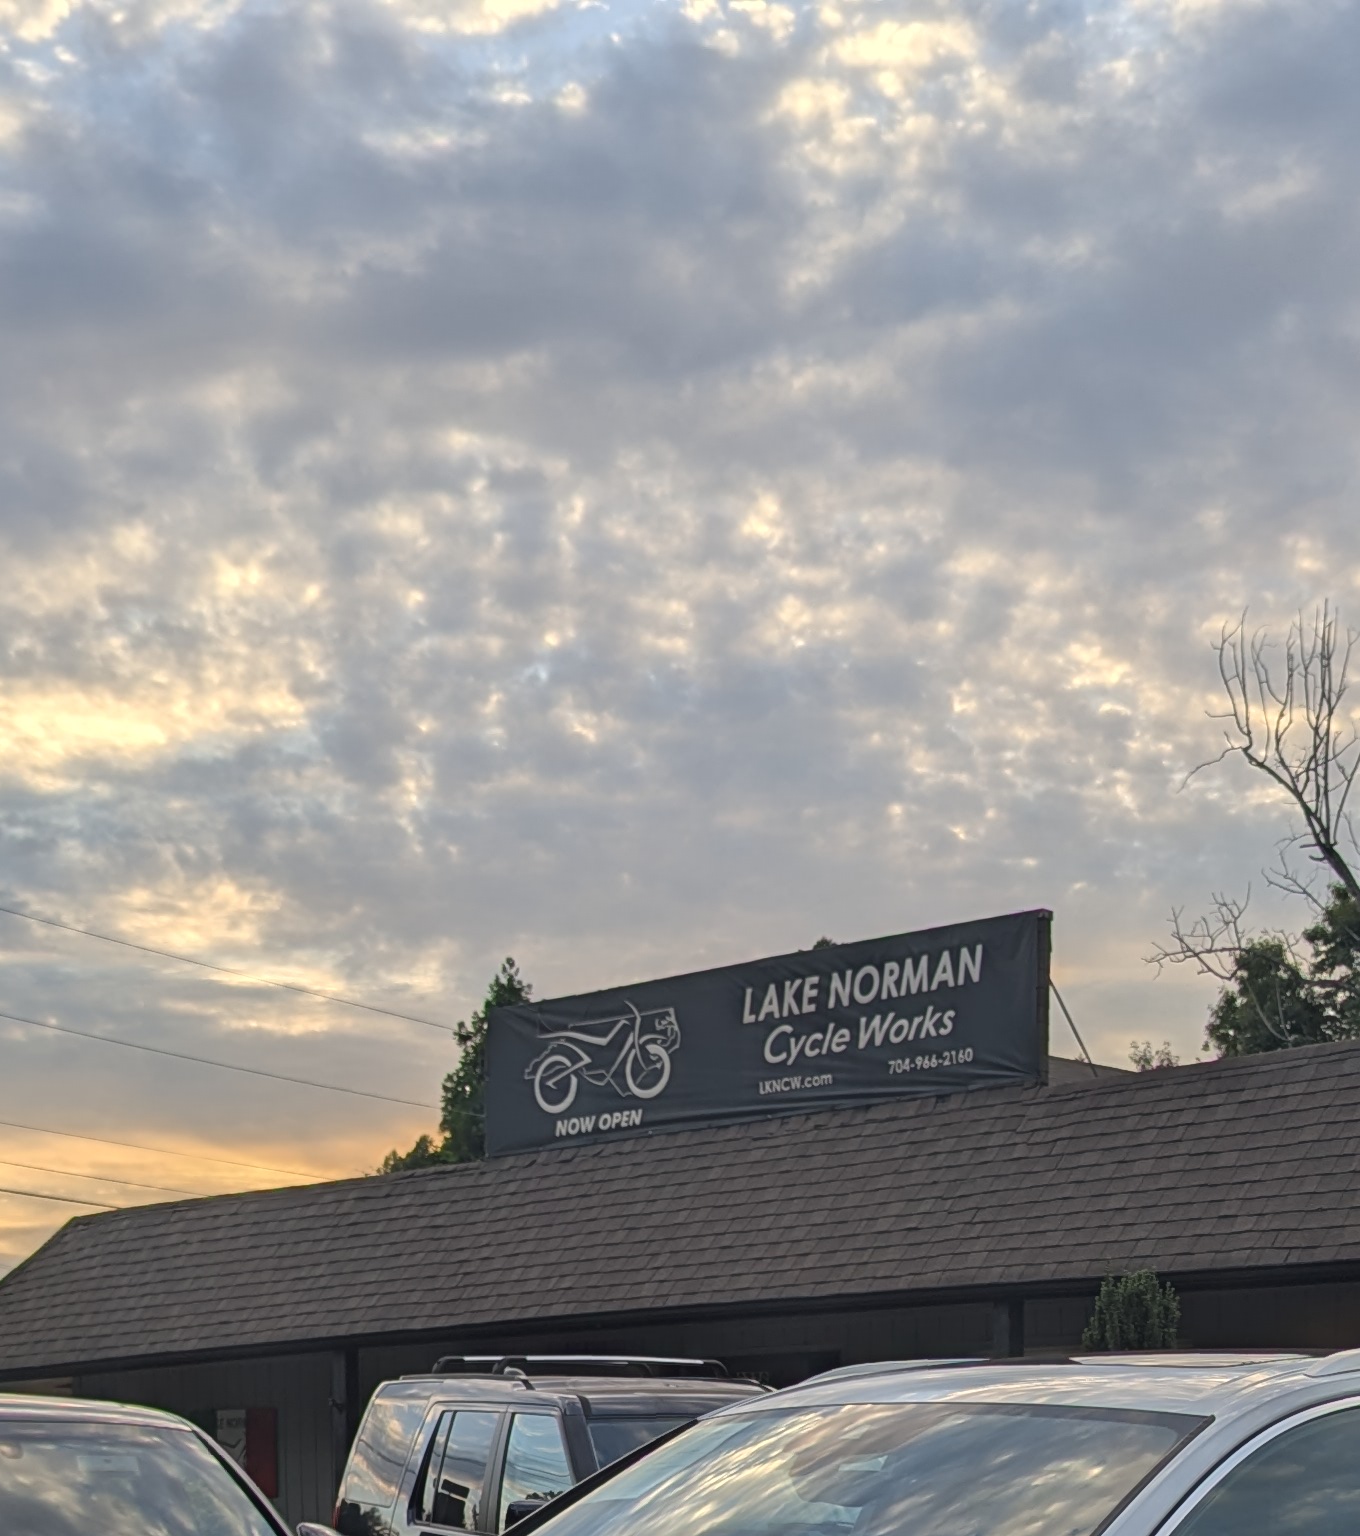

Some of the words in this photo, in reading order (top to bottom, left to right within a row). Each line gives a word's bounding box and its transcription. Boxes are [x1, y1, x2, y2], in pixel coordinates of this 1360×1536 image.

[742, 974, 820, 1025] LAKE
[827, 943, 984, 1010] NORMAN
[762, 1022, 852, 1066] Cycle
[857, 1004, 956, 1051] Works
[888, 1047, 974, 1075] 704-966-2160
[758, 1072, 833, 1095] LKNCW.com
[554, 1115, 596, 1138] NOW
[598, 1108, 644, 1132] OPEN
